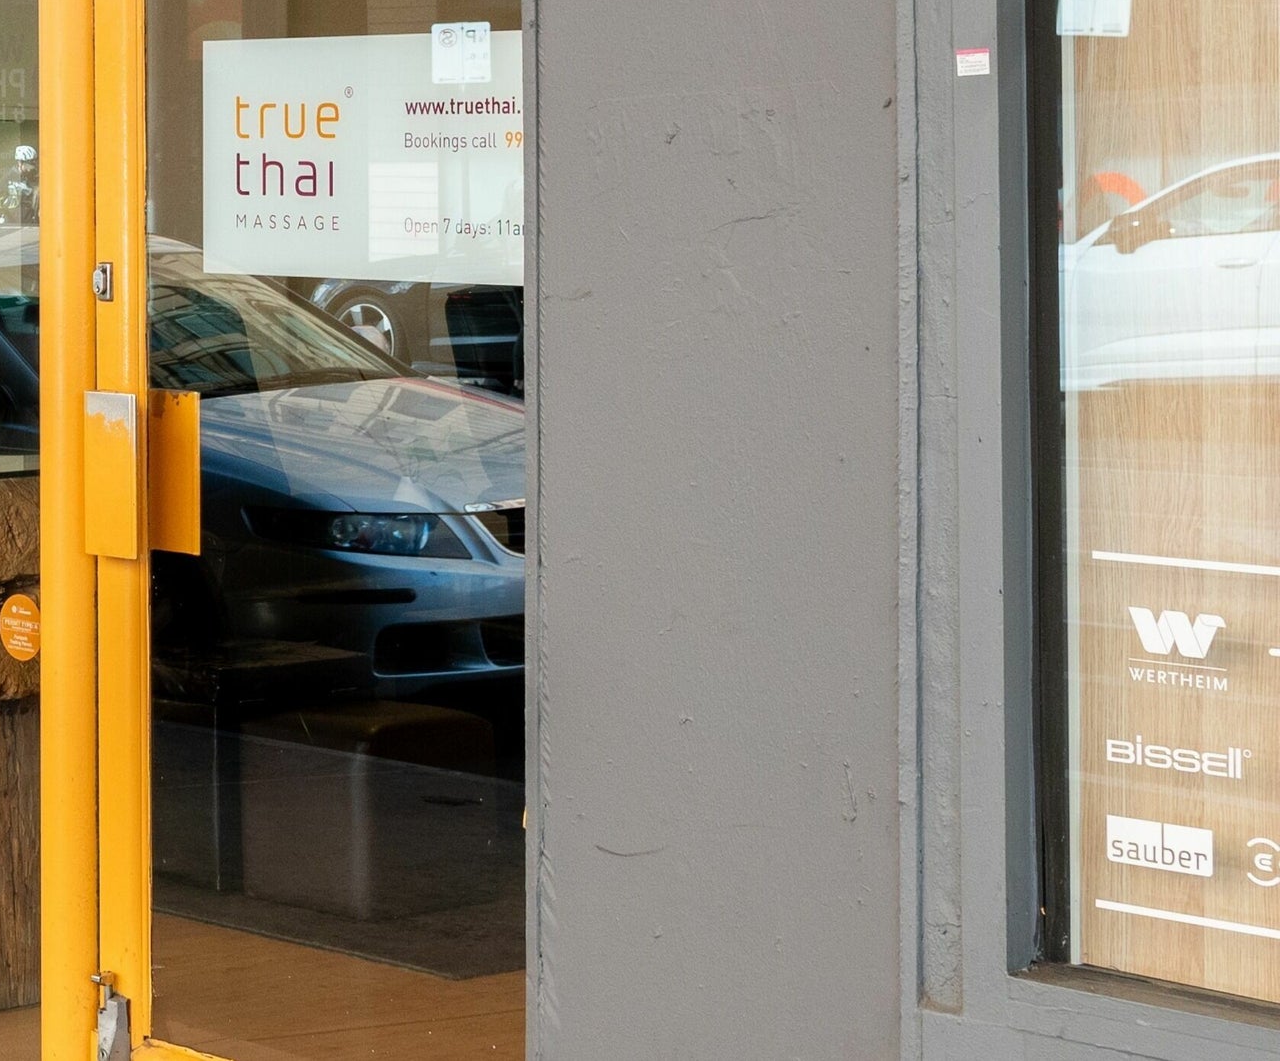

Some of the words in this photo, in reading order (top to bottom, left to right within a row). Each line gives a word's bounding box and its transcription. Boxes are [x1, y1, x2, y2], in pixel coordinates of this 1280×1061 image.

[235, 95, 339, 139] true
[404, 132, 467, 152] Bookings
[472, 132, 497, 148] call
[235, 153, 335, 197] thai
[236, 214, 339, 231] MASSAGE
[404, 217, 438, 237] Open
[443, 218, 451, 234] 7
[455, 219, 491, 239] days:
[497, 219, 524, 236] 11a
[1129, 666, 1228, 691] WERTHEIM
[1111, 824, 1208, 871] sauber
